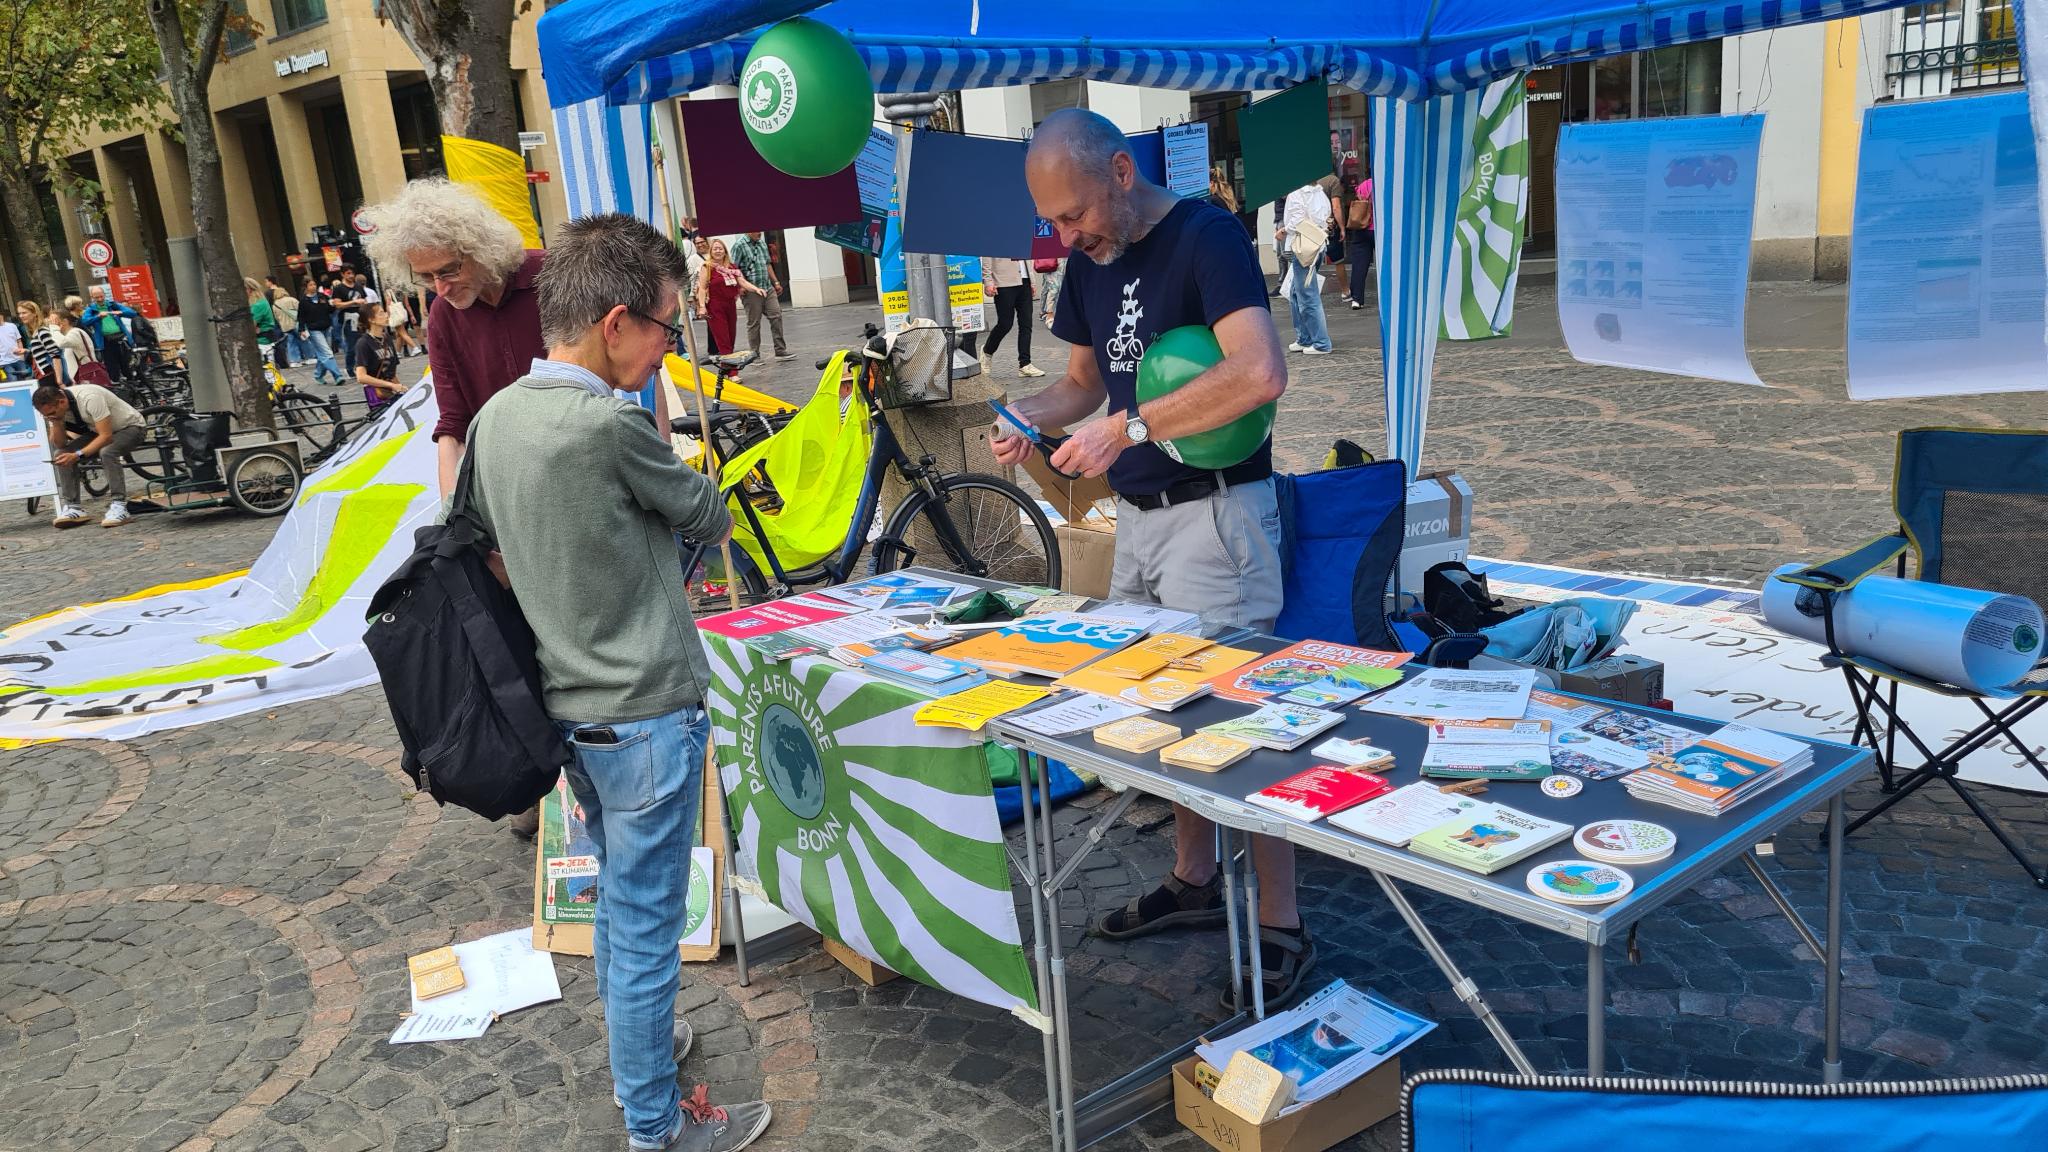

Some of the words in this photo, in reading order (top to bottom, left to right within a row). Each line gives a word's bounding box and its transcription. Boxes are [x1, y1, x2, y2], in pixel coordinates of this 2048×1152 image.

[743, 60, 762, 89] BONN
[777, 67, 793, 119] PARENTS
[745, 107, 773, 131] FUTURE
[1110, 361, 1133, 372] BIKE
[1405, 518, 1450, 538] RKZON
[1302, 643, 1397, 664] GENUG
[741, 682, 766, 795] PARENTS
[797, 811, 843, 852] BONN
[1495, 815, 1537, 830] MORGEN
[567, 858, 588, 868] JEDE
